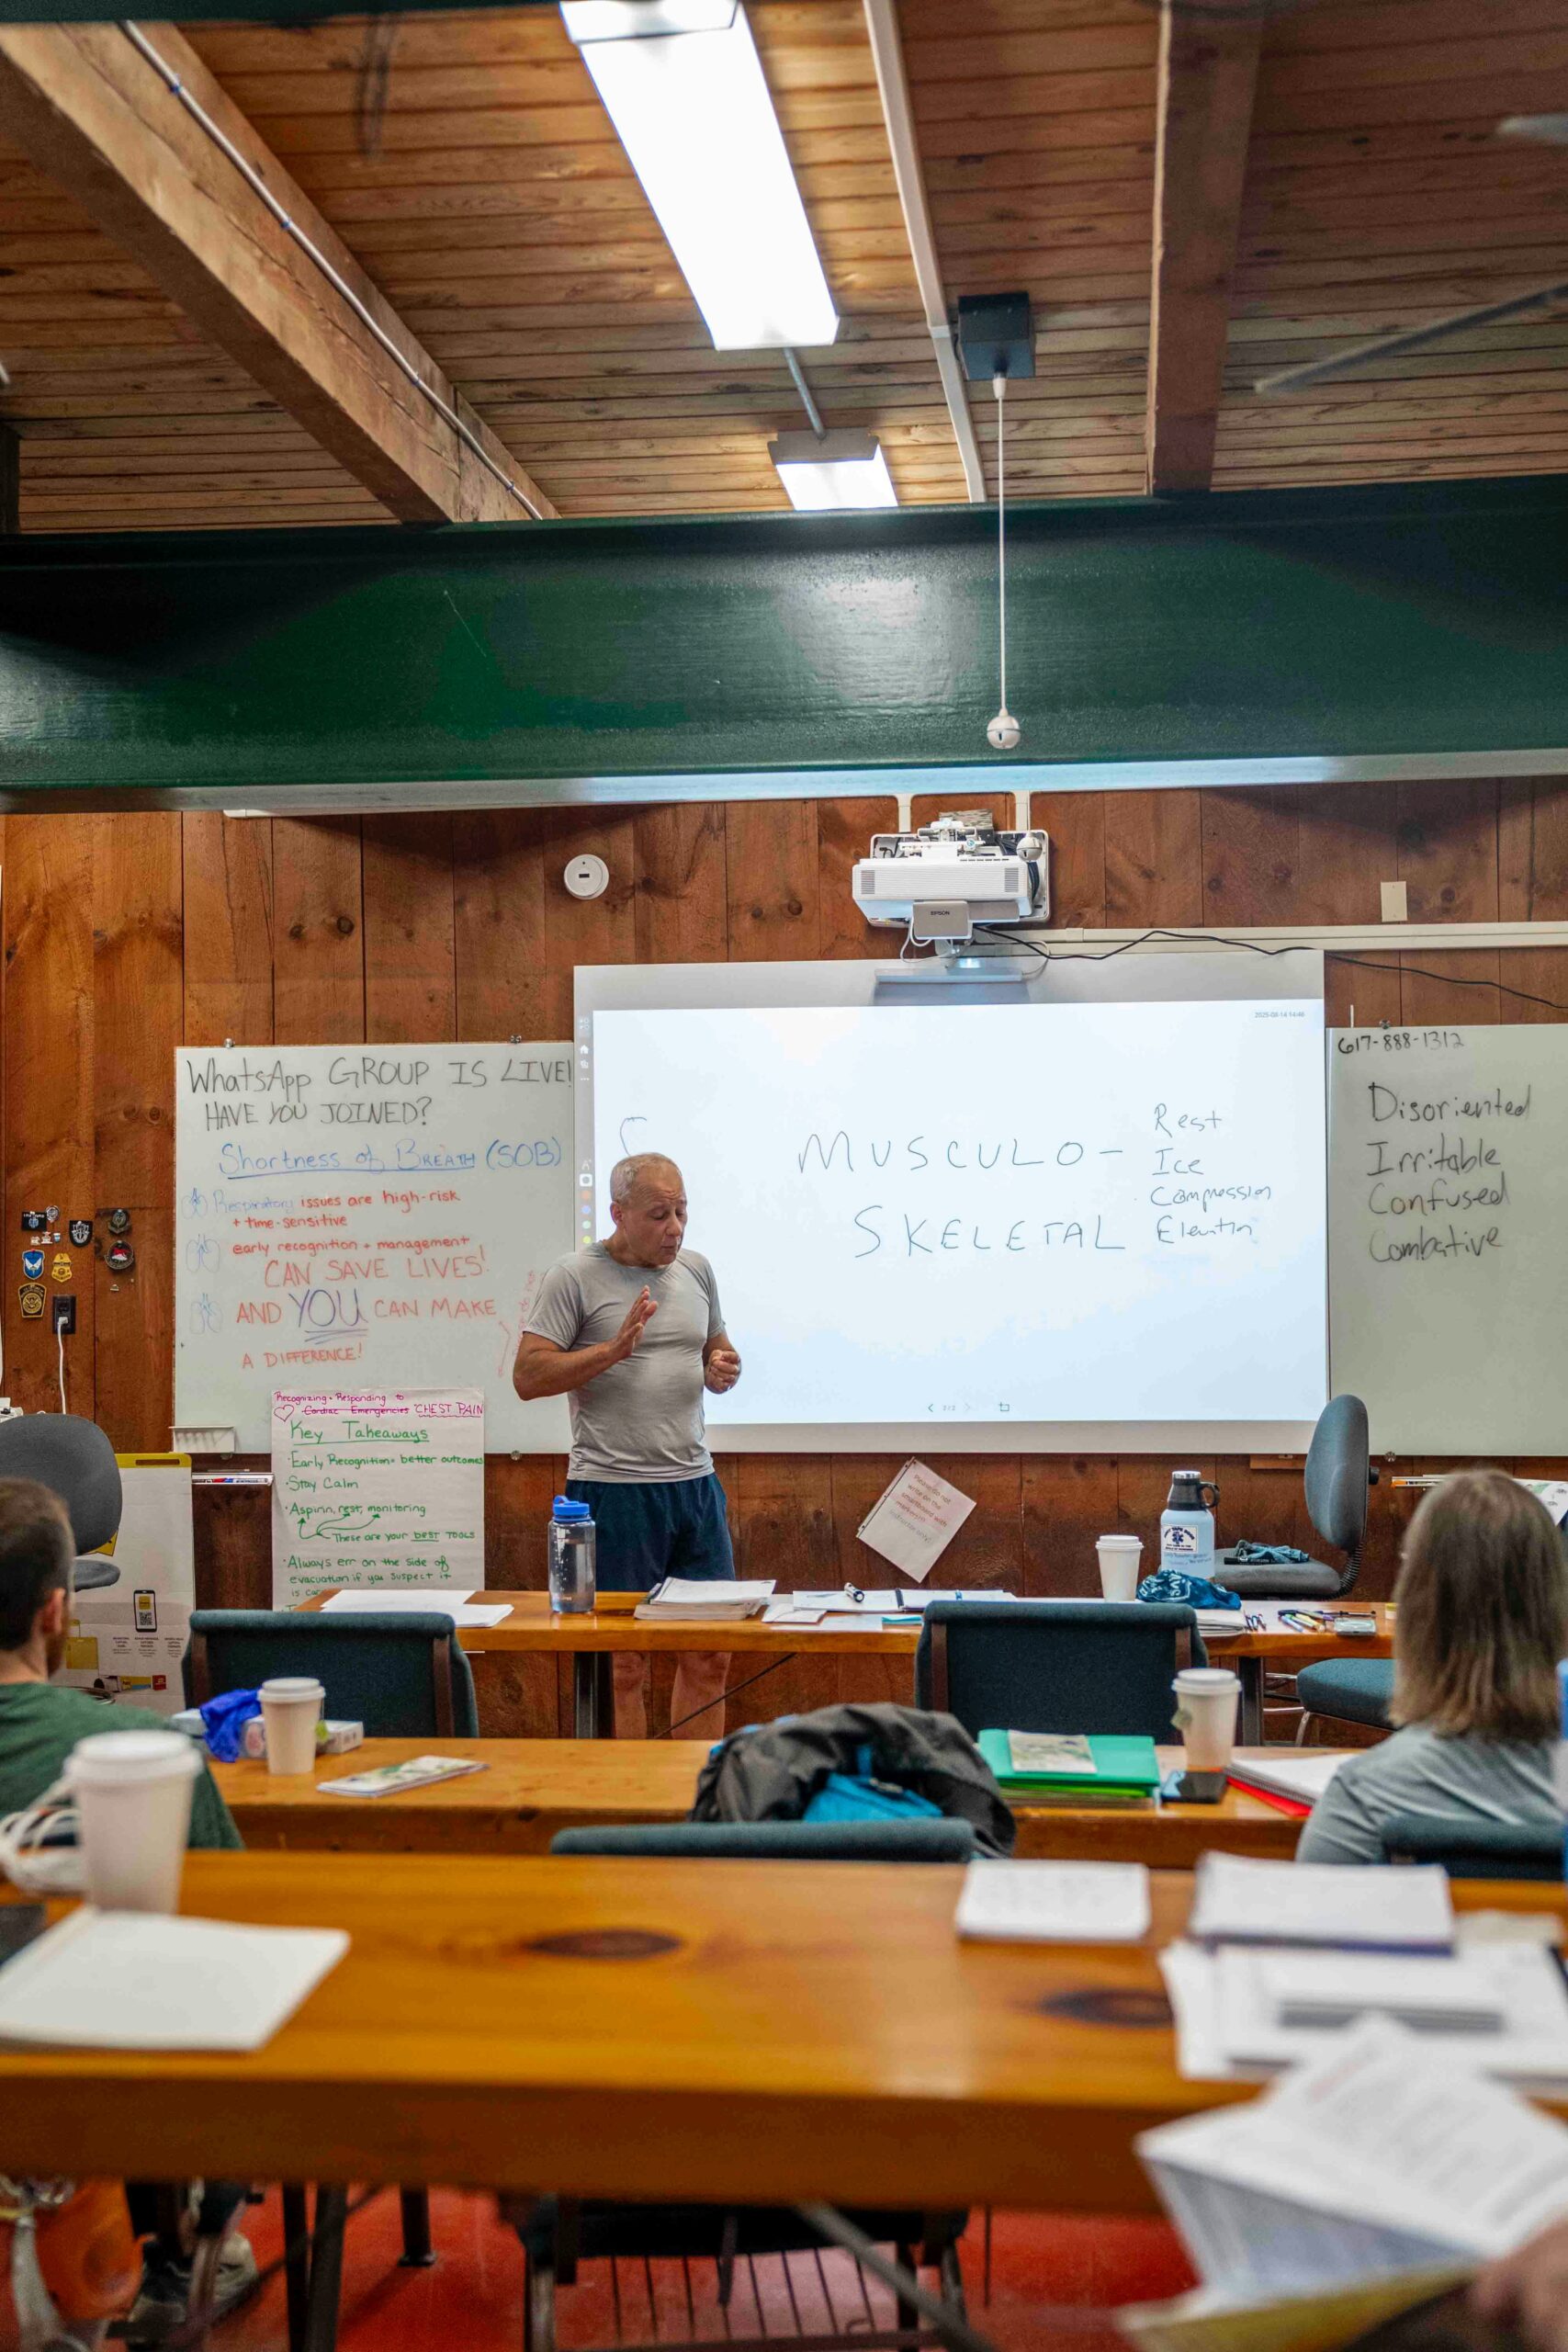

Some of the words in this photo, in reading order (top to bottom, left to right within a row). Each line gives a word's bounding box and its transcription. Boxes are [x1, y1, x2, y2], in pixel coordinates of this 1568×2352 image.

[1337, 1031, 1464, 1054] 617-888-1312
[186, 1057, 311, 1102] WhatsApp
[329, 1057, 429, 1090] GROUP
[448, 1060, 487, 1088] IS
[501, 1058, 571, 1089] LIVE!
[1369, 1081, 1531, 1121] Disoriented
[205, 1102, 258, 1131] HAVE
[269, 1102, 308, 1125] YOU
[321, 1096, 432, 1126] JOINED?
[1154, 1102, 1223, 1138] Rest
[219, 1144, 340, 1175] Shortness
[355, 1145, 385, 1174] of
[486, 1137, 561, 1170] (SOB)
[1152, 1148, 1204, 1176] Ice
[1367, 1133, 1502, 1176] Irritable
[300, 1194, 342, 1208] issues
[347, 1195, 372, 1207] are
[382, 1191, 461, 1213] high-risk
[1369, 1171, 1510, 1216] Confused
[244, 1214, 347, 1228] time-sensitive
[854, 1205, 1126, 1258] SKELETAL
[232, 1242, 269, 1257] early
[277, 1239, 357, 1257] recognition
[377, 1236, 470, 1255] management
[1370, 1225, 1504, 1262] Combative
[265, 1259, 310, 1287] CAN
[325, 1259, 389, 1281] SAVE
[407, 1244, 490, 1279] LIVES!
[236, 1301, 282, 1324] AND
[288, 1288, 368, 1328] YOU
[374, 1300, 419, 1318] CAN
[431, 1299, 497, 1317] MAKE
[242, 1352, 254, 1369] A
[265, 1343, 363, 1367] DIFFERENCE!
[274, 1391, 327, 1406] Recognizing
[334, 1392, 386, 1407] Responding
[395, 1393, 405, 1401] to
[351, 1405, 410, 1418] Emergencies
[456, 1401, 483, 1416] PAIN
[290, 1420, 323, 1444] Key
[342, 1420, 430, 1443] Takeaways
[290, 1451, 323, 1470] Early
[327, 1453, 390, 1469] Recognition
[400, 1453, 437, 1464] better
[441, 1454, 483, 1464] outcomes
[288, 1476, 316, 1492] Stay
[323, 1476, 359, 1488] Calm
[908, 1484, 922, 1496] write
[931, 1500, 941, 1509] the
[288, 1502, 335, 1520] Aspirin,
[367, 1503, 426, 1517] monitoring
[333, 1533, 361, 1543] These
[385, 1532, 408, 1542] your
[288, 1555, 332, 1570] Always
[382, 1557, 400, 1566] the
[406, 1557, 427, 1566] side
[434, 1555, 449, 1573] of
[289, 1576, 349, 1584] evacuation
[352, 1573, 361, 1582] if
[367, 1575, 384, 1584] you
[390, 1572, 434, 1583] suspect
[291, 1589, 299, 1598] is
